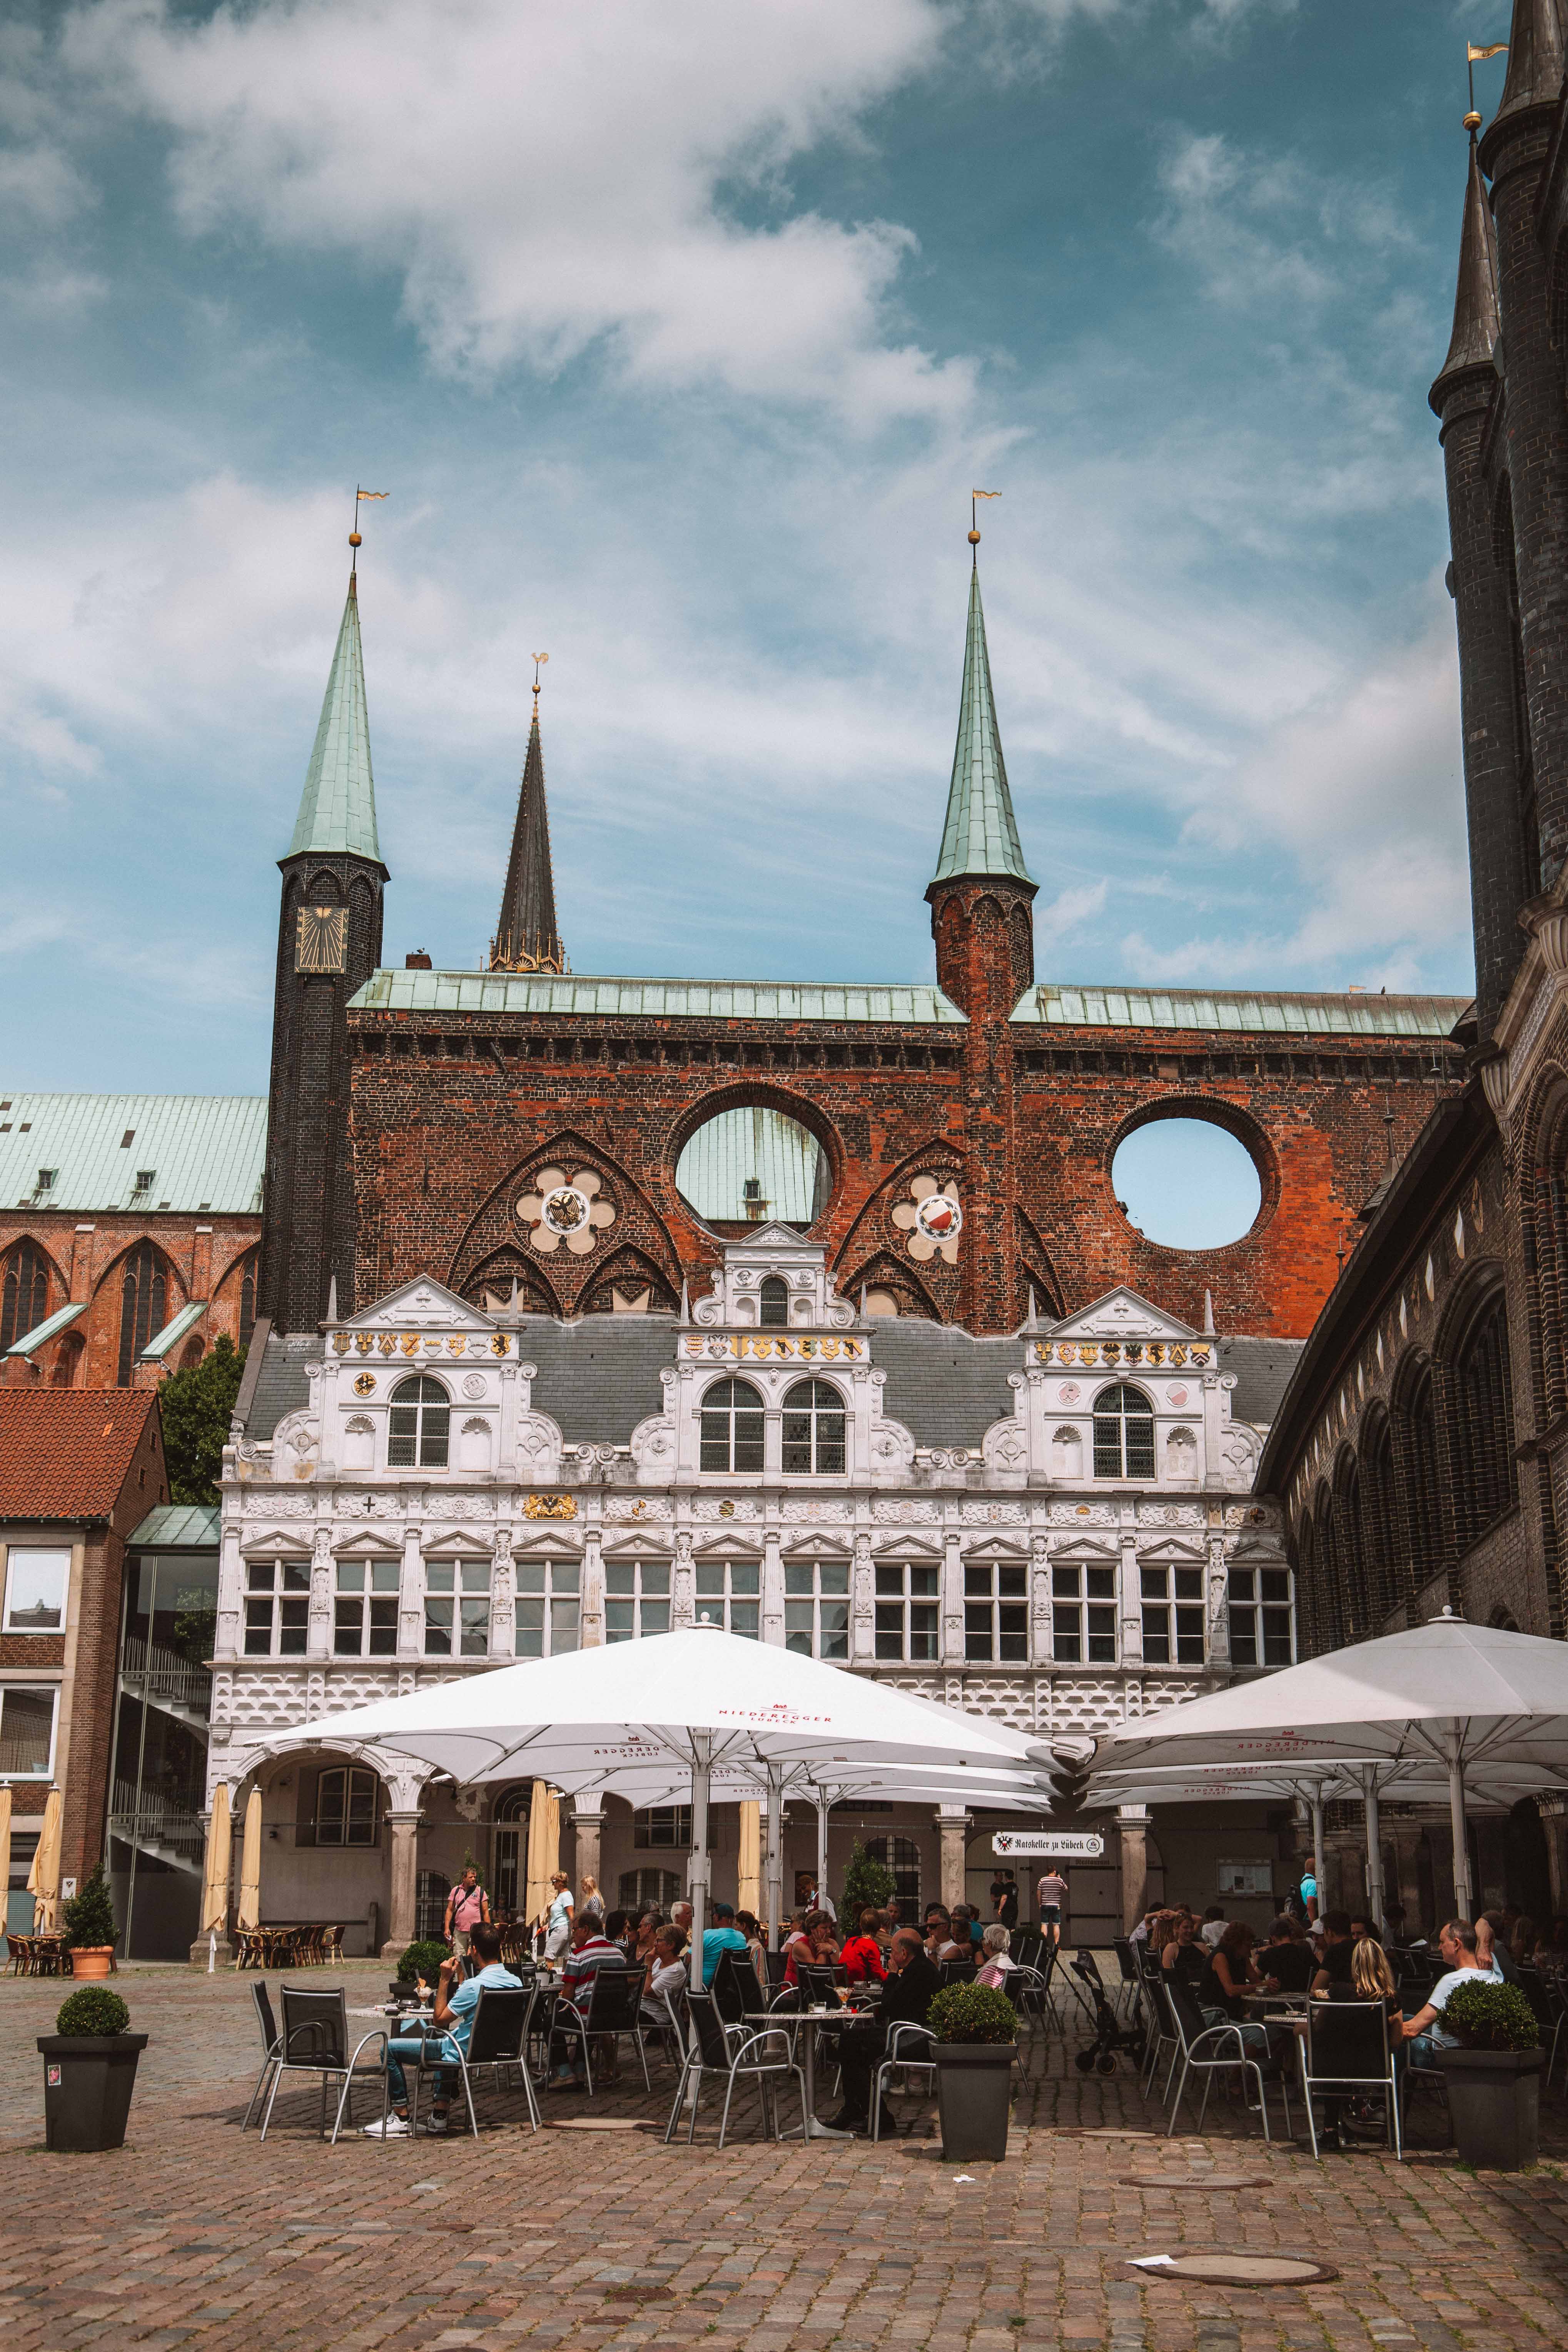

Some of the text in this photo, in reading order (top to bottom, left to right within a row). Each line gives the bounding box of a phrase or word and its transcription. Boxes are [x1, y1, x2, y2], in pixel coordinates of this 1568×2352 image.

[719, 1710, 831, 1722] NIEDEREGGER
[1015, 1839, 1084, 1851] Ratskeller zu Lübeck
